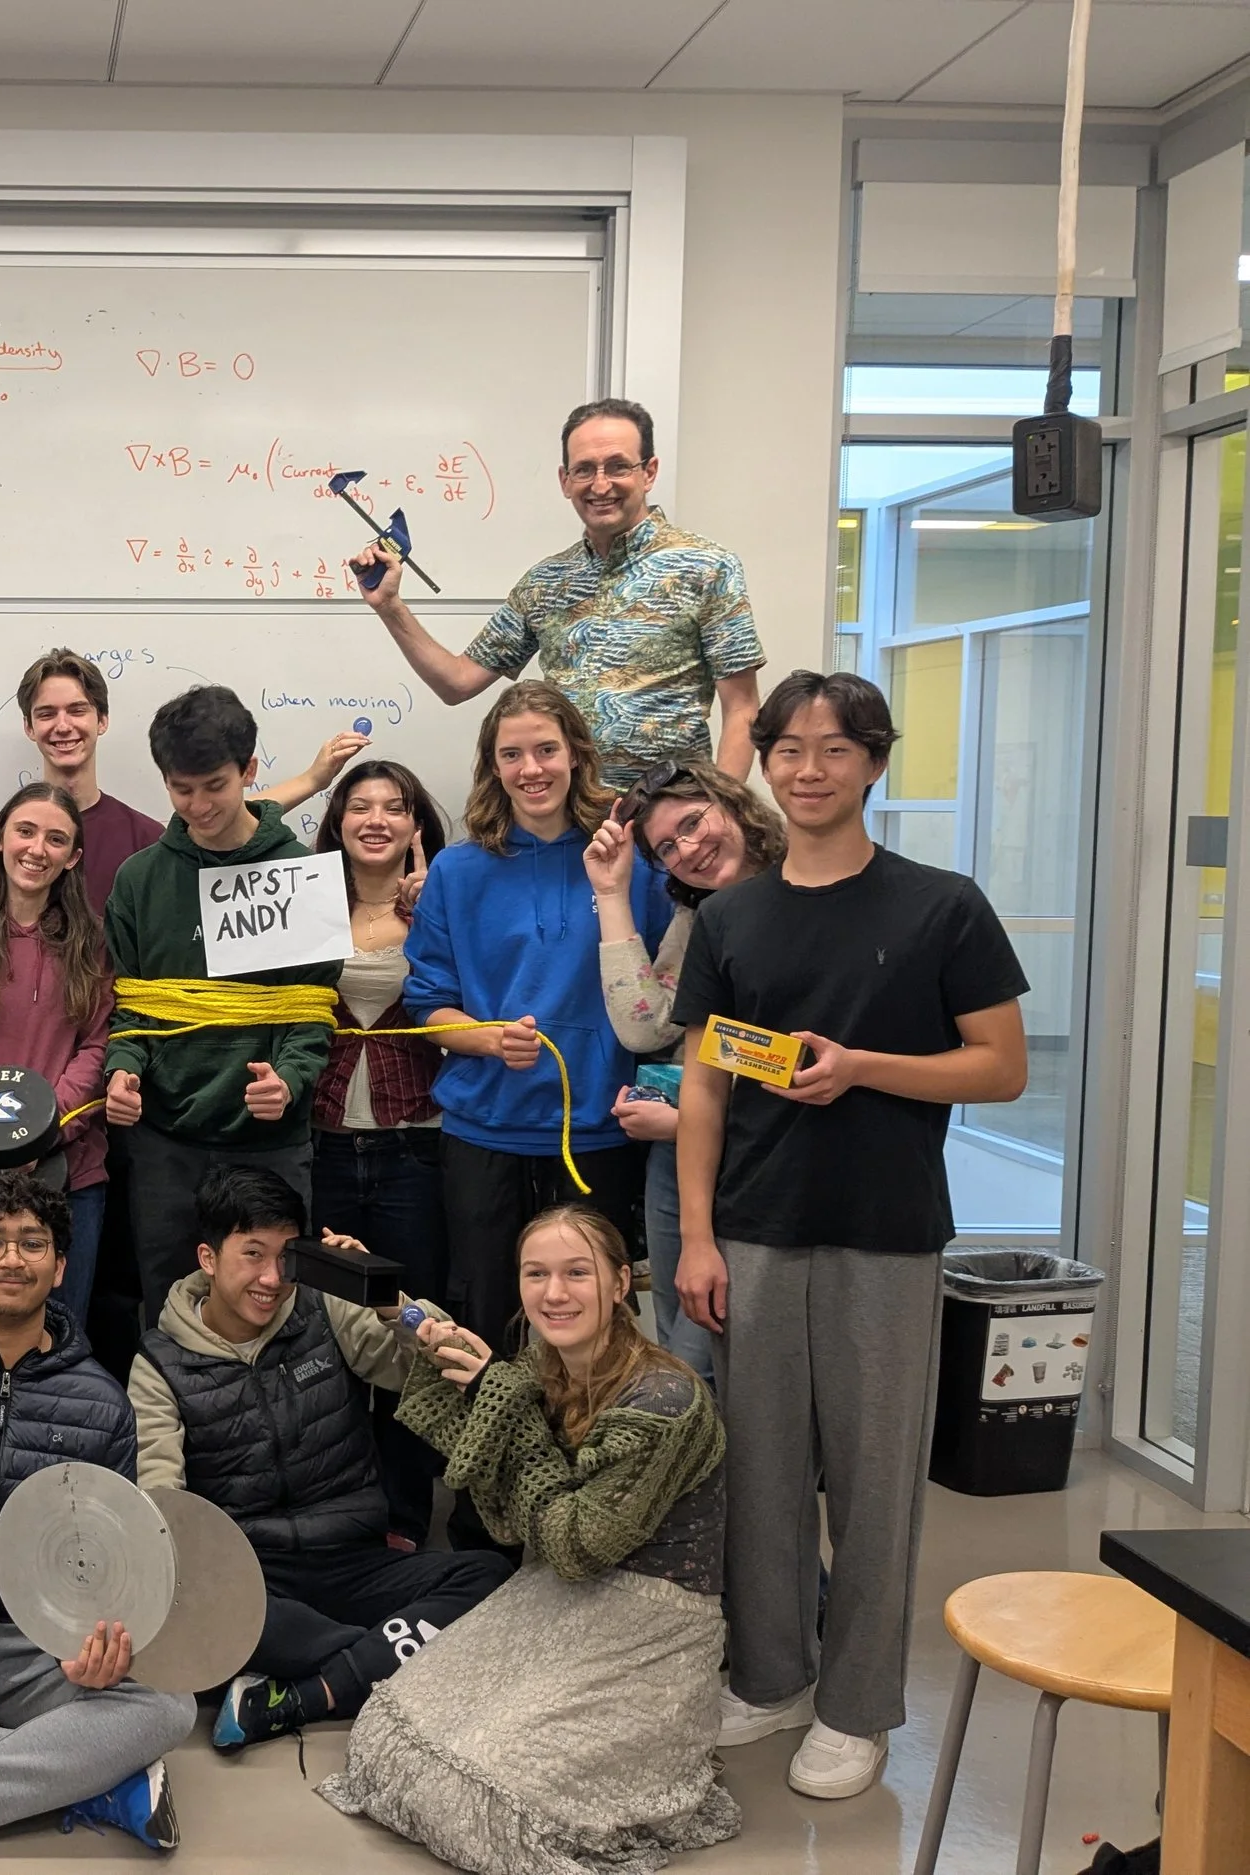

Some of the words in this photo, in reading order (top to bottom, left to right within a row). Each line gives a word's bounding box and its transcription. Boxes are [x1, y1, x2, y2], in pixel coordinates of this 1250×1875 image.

[209, 865, 320, 904] CAPST-
[215, 897, 293, 942] ANDY
[735, 1058, 782, 1076] FLASHBULBS
[11, 1126, 29, 1140] 40
[1021, 1303, 1057, 1312] LANDFILL
[292, 1359, 316, 1376] EDDIE
[295, 1366, 320, 1383] BAUER
